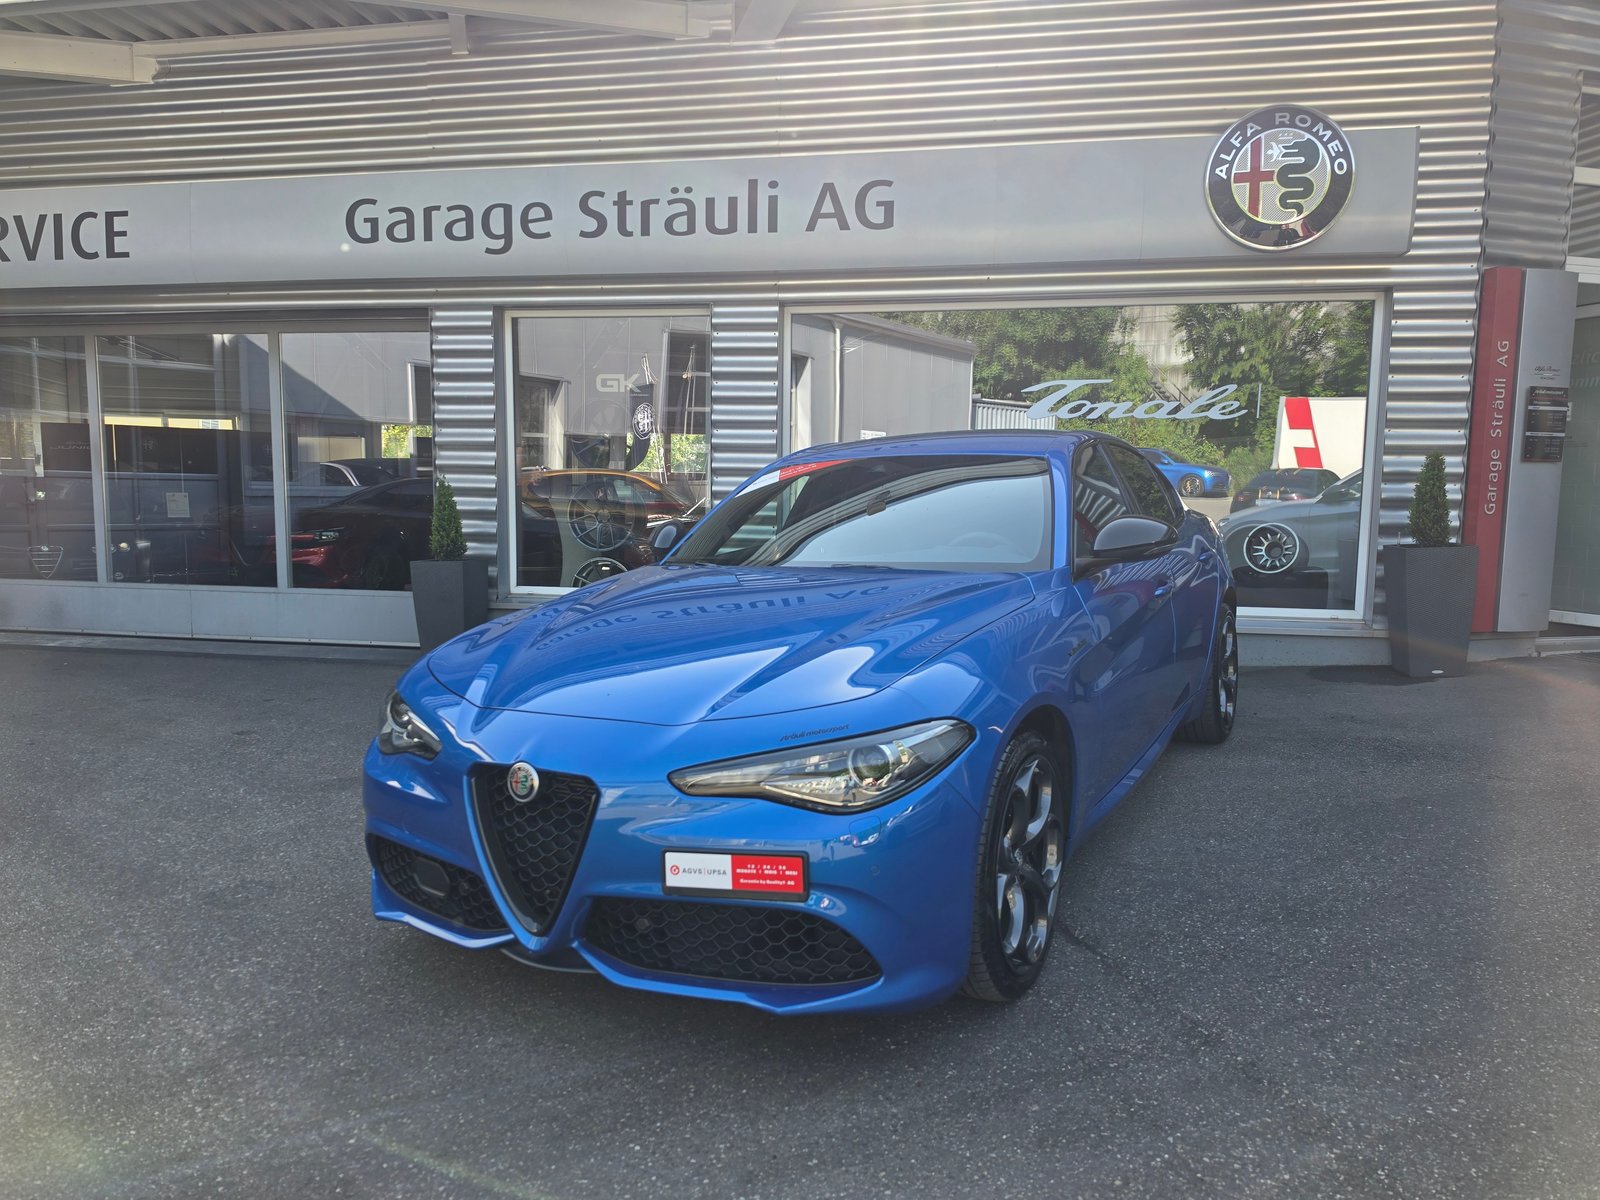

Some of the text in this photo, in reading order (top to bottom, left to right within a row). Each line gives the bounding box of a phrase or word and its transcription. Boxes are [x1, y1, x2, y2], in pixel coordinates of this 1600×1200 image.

[1214, 112, 1348, 180] ALFA ROMEO
[345, 178, 895, 255] Garage Sträuli AG
[1020, 379, 1248, 420] Tonale
[1484, 340, 1510, 515] Garage Sträuli AG
